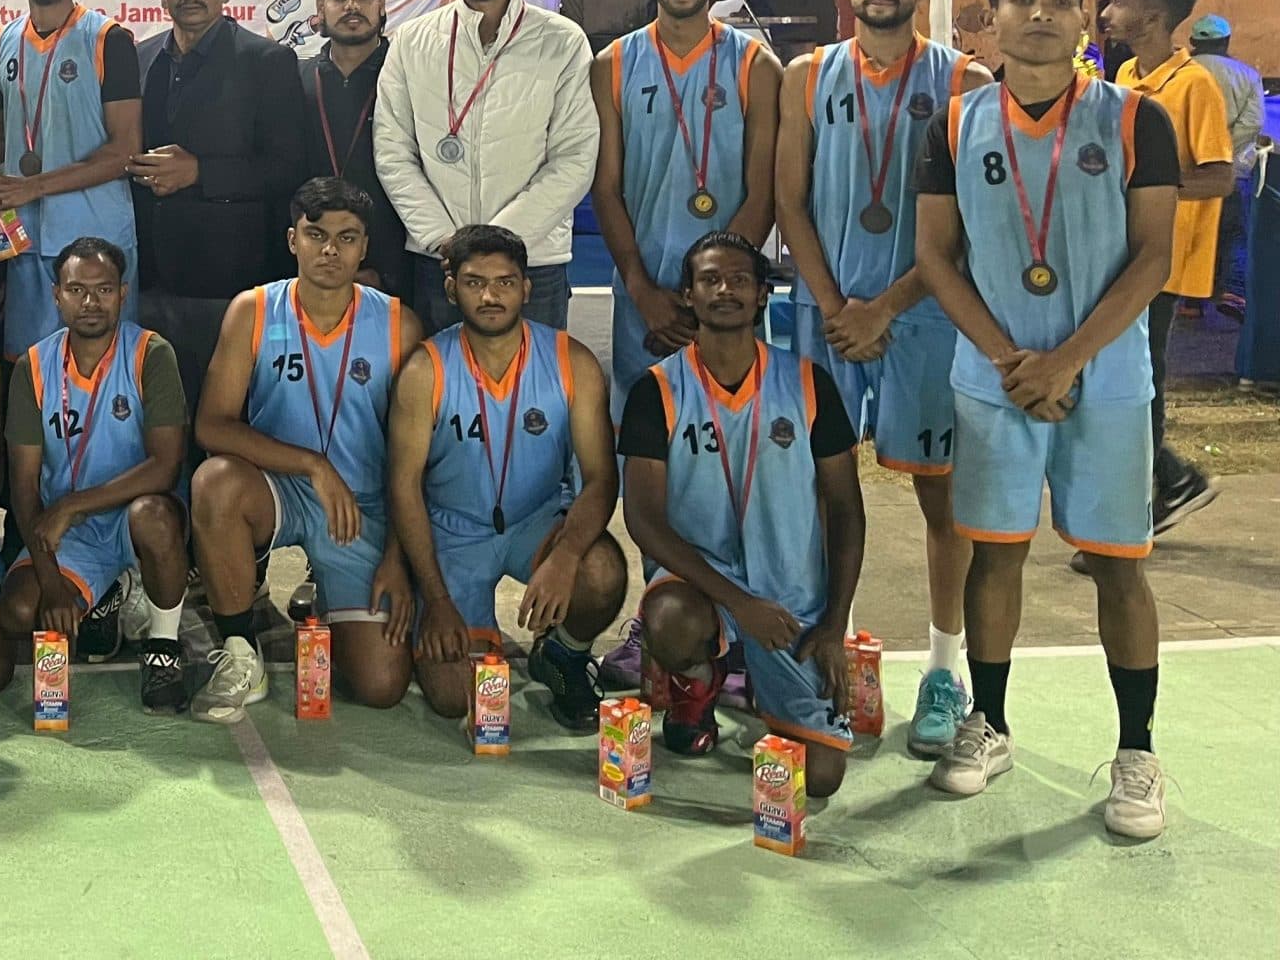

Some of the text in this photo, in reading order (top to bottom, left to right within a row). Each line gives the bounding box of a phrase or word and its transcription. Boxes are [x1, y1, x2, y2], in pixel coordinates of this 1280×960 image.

[6, 58, 19, 82] 9
[641, 85, 659, 114] 7
[825, 93, 856, 125] 11
[982, 151, 1007, 186] 8
[272, 352, 304, 383] 15
[48, 409, 83, 440] 12
[449, 413, 486, 443] 14
[682, 422, 720, 456] 13
[917, 428, 953, 459] 11
